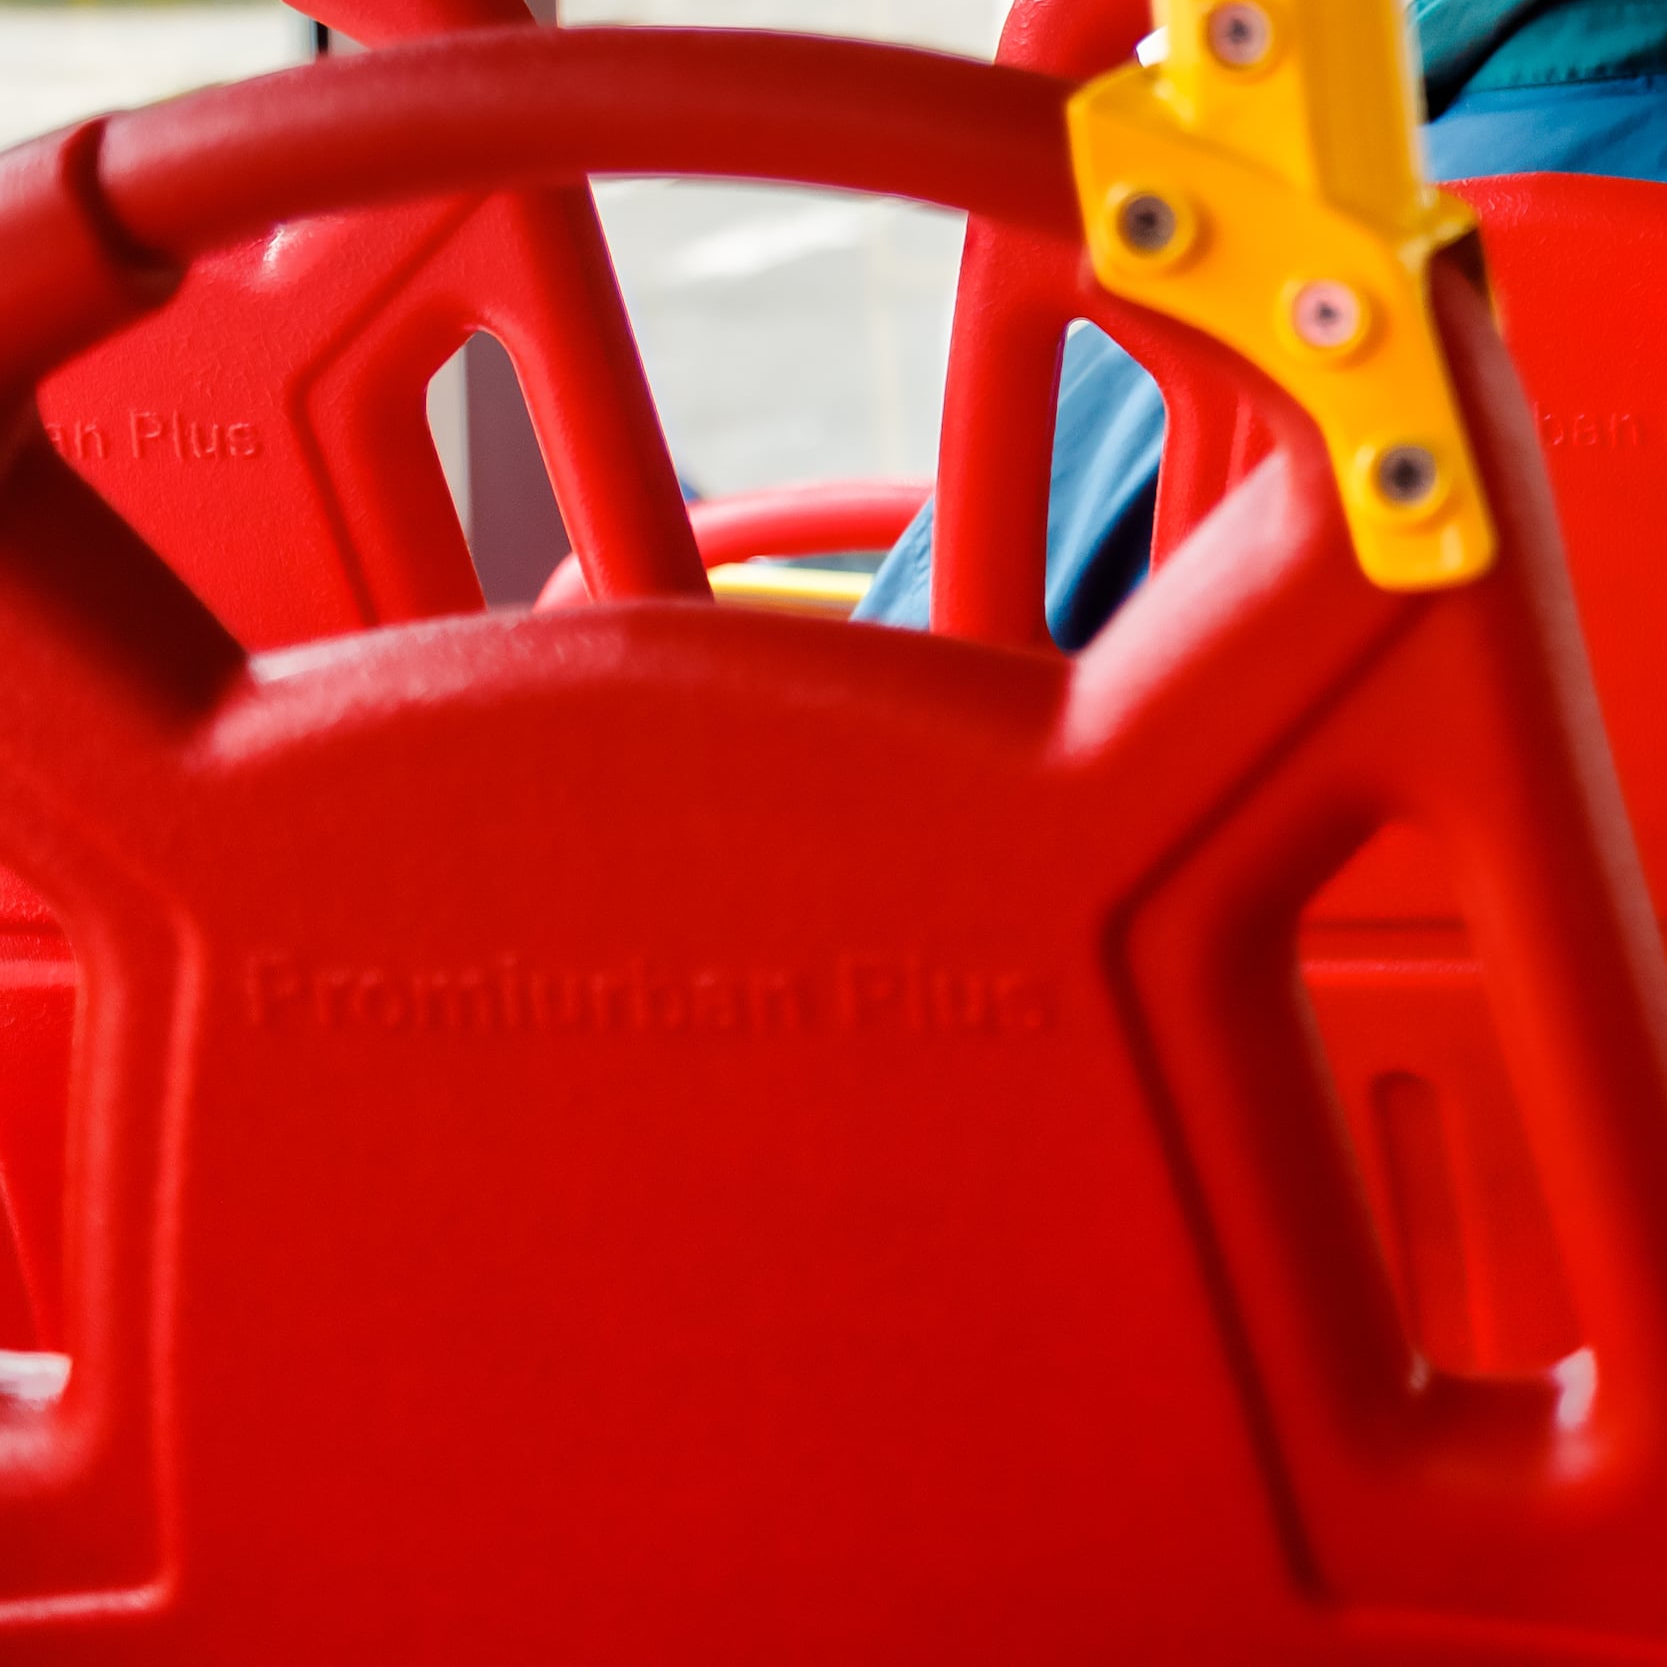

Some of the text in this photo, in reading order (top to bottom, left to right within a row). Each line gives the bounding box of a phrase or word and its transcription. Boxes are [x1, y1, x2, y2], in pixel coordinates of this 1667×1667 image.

[129, 407, 263, 460] Plus
[240, 947, 1060, 1033] Promiurban Plus
